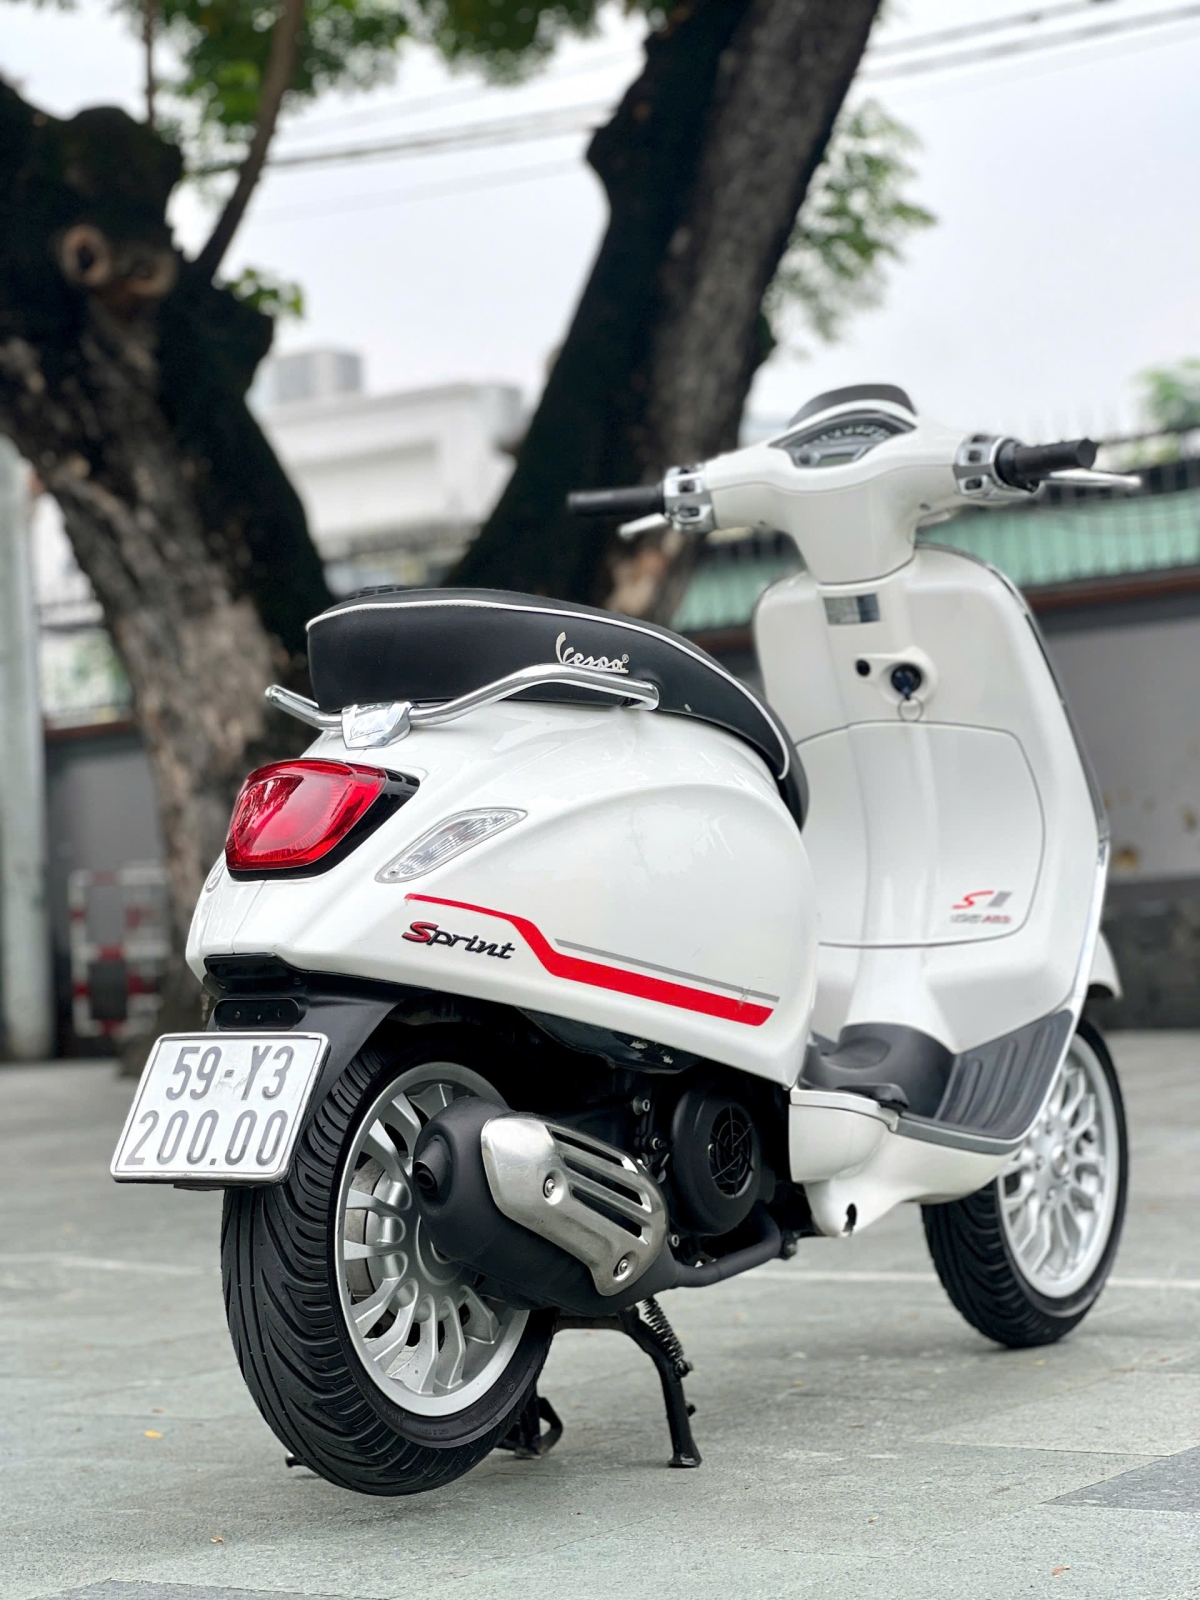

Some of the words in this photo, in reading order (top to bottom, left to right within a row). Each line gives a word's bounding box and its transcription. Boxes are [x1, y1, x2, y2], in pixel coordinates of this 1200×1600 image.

[402, 921, 515, 959] Sprint
[166, 1046, 295, 1100] 59-Y3
[124, 1109, 288, 1166] 200.00
